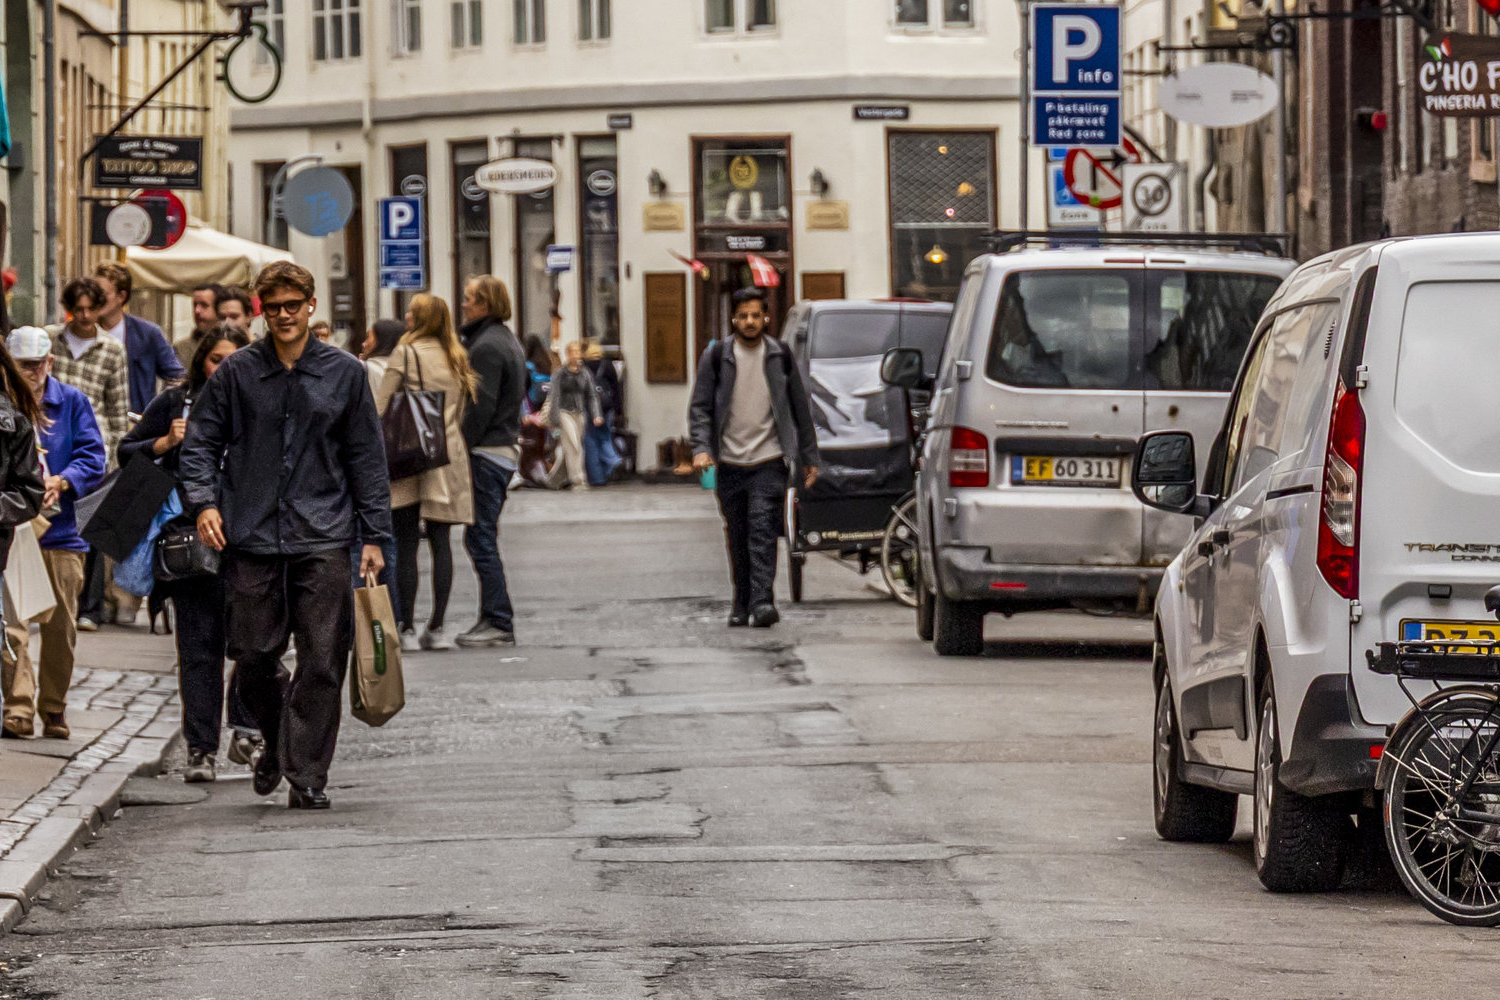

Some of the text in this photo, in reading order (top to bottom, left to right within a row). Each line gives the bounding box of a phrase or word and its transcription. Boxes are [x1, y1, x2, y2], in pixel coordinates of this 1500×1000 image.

[1052, 14, 1103, 83] P
[1078, 67, 1114, 84] info
[1420, 61, 1479, 92] C'HO
[1076, 129, 1106, 139] zone
[389, 202, 414, 238] P
[1026, 458, 1114, 478] EF 60 311
